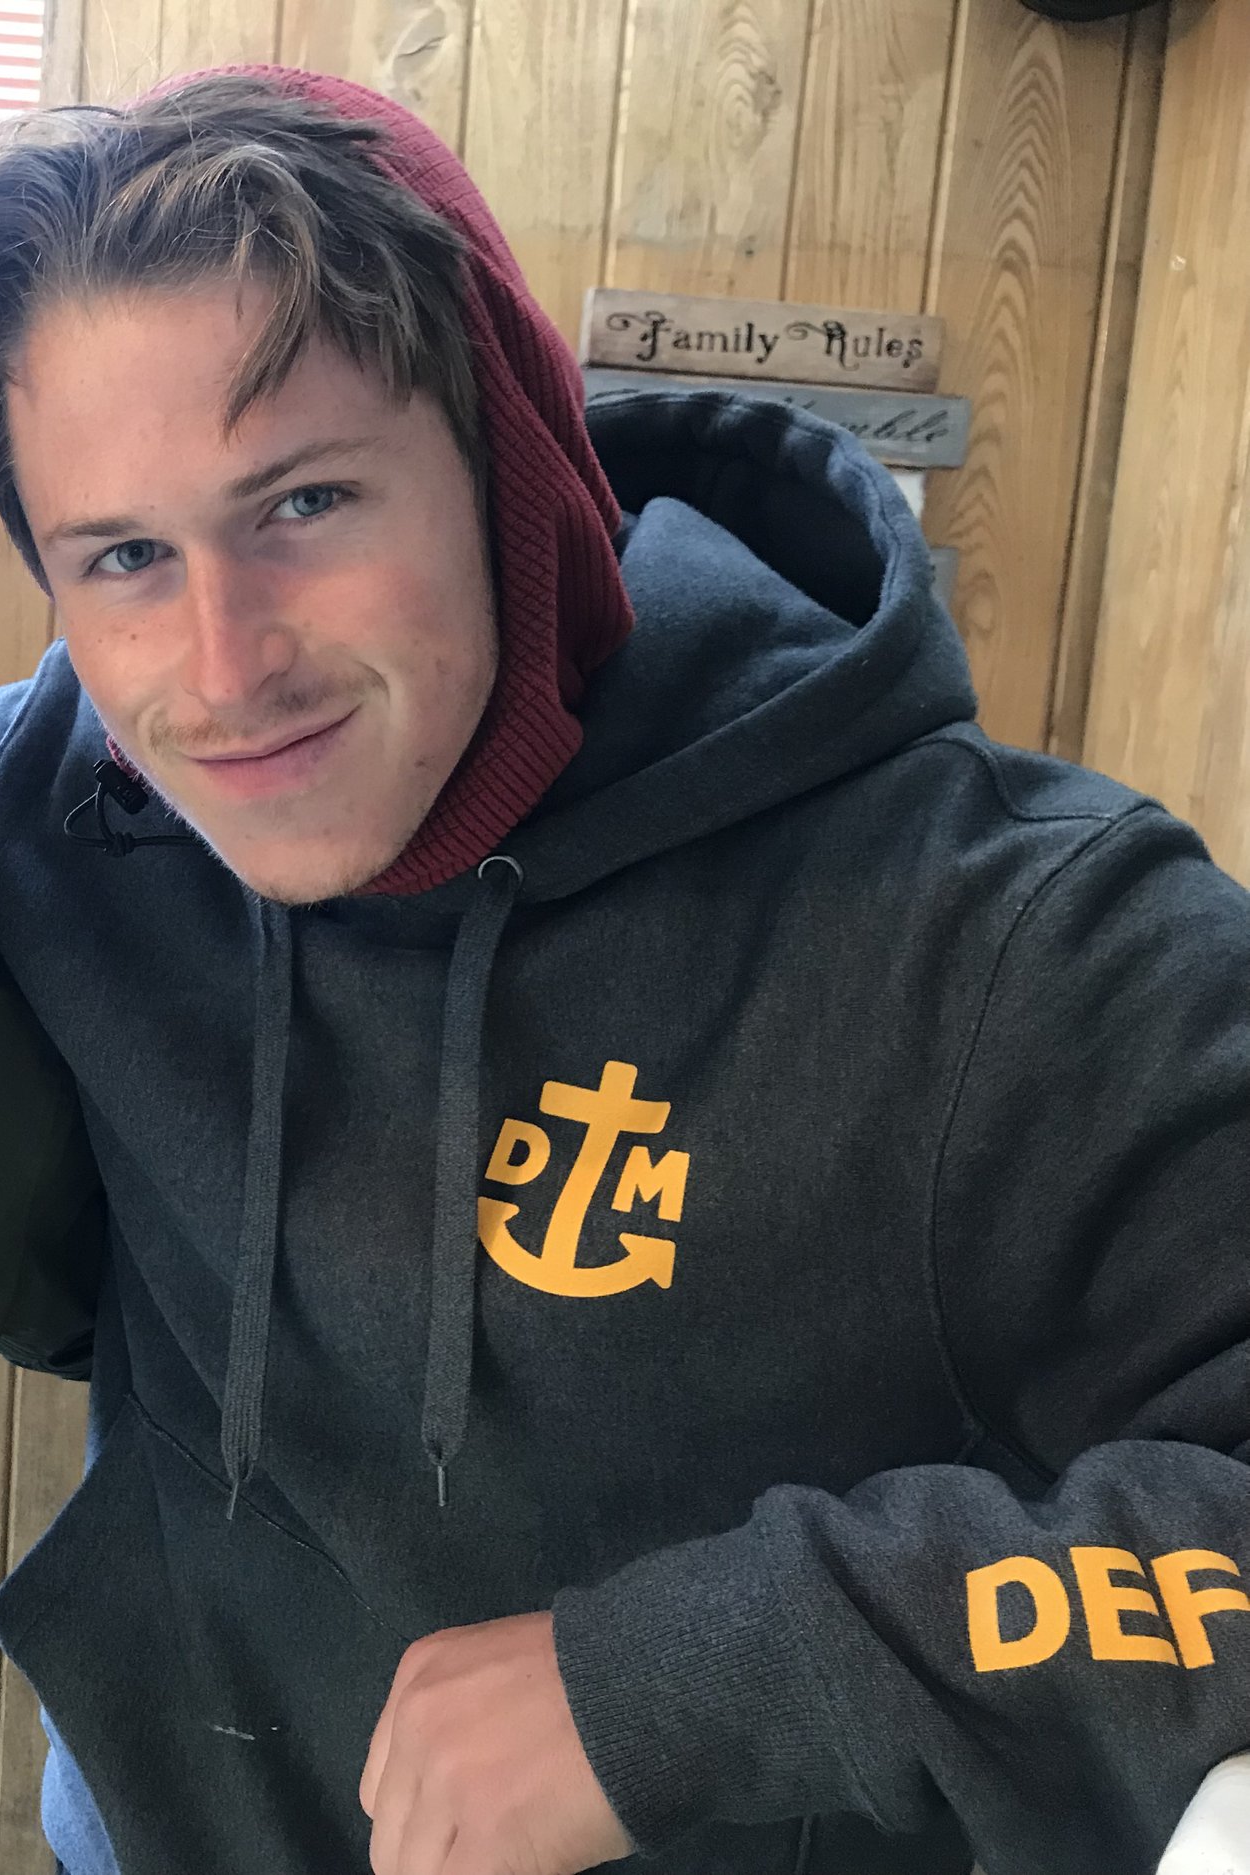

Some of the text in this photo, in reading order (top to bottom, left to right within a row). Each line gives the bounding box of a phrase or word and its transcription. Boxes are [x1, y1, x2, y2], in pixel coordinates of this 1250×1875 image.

[606, 310, 924, 372] Family Rules
[966, 1546, 1250, 1673] DEF
